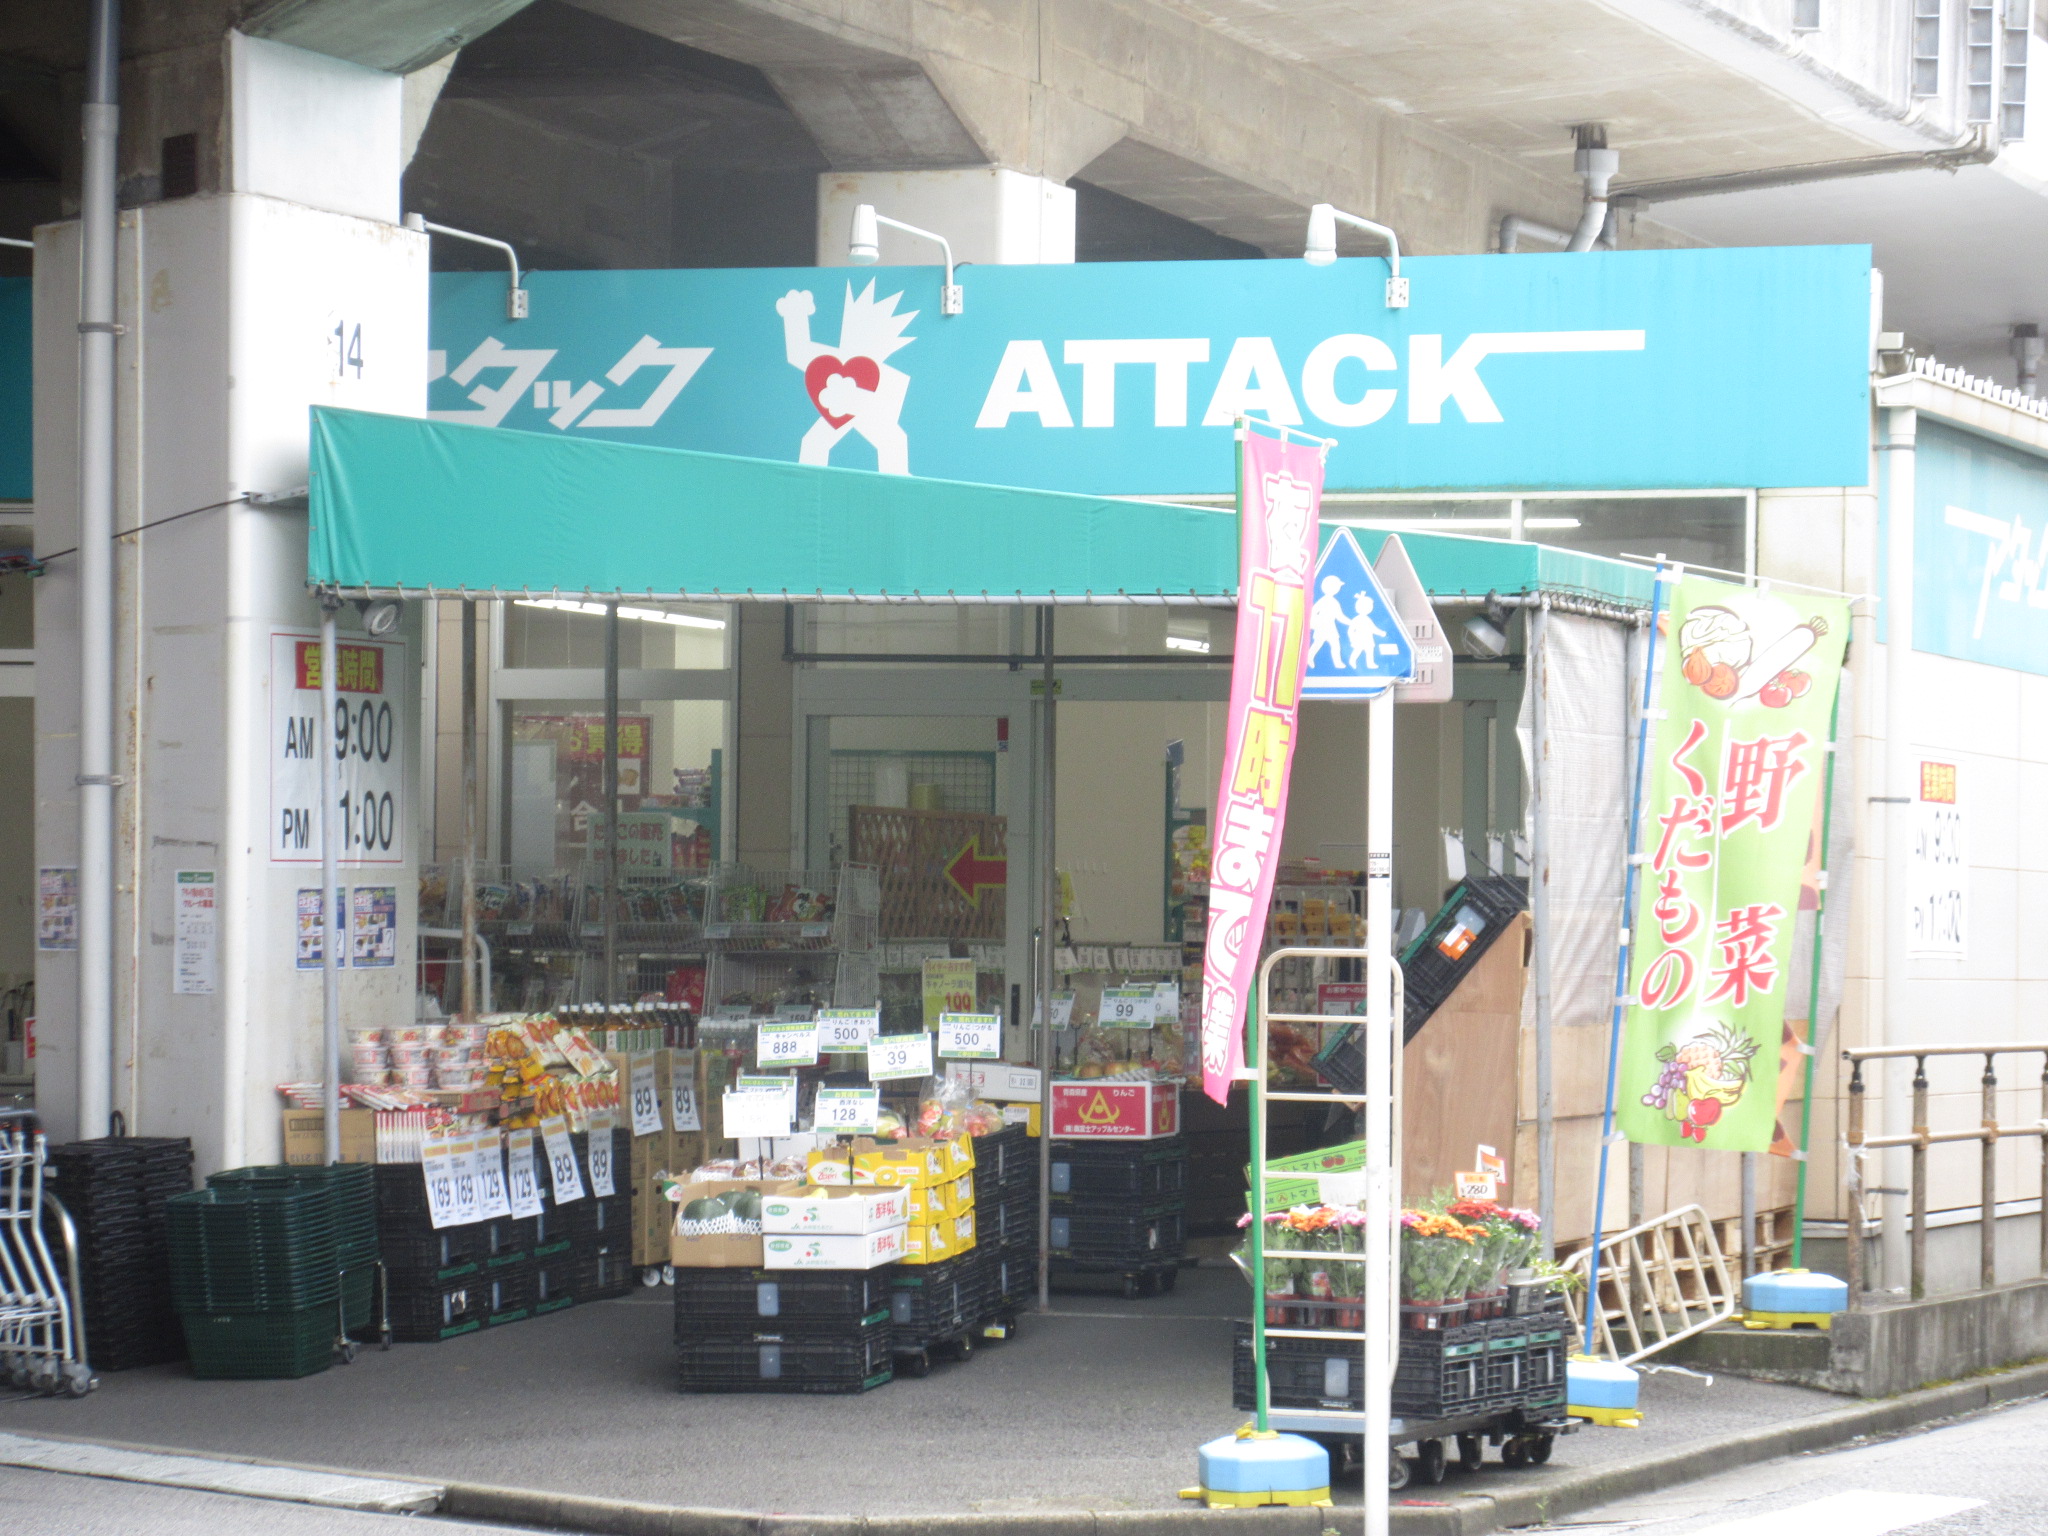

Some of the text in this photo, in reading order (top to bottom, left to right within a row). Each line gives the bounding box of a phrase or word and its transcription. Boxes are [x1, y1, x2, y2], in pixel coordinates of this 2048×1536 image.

[334, 319, 364, 380] 14
[974, 330, 1646, 428] ATTACK
[284, 697, 394, 763] AM 9:00
[282, 807, 310, 850] PM
[1640, 719, 1716, 1009] くだもの
[1702, 731, 1809, 1006] 野菜
[1115, 1004, 1134, 1017] 99
[772, 1041, 797, 1054] 888
[834, 1027, 859, 1040] 500
[954, 1033, 980, 1046] 500
[887, 1051, 907, 1066] 39
[635, 1085, 653, 1117] 89
[675, 1085, 691, 1114] 89
[1113, 1088, 1136, 1097] りんご
[832, 1108, 857, 1121] 128
[554, 1153, 573, 1185] 89
[592, 1149, 608, 1179] 89
[431, 1176, 451, 1209] 169
[455, 1173, 473, 1206] 169
[481, 1168, 500, 1200] 129
[513, 1168, 532, 1200] 129
[1290, 1188, 1319, 1199] トマト
